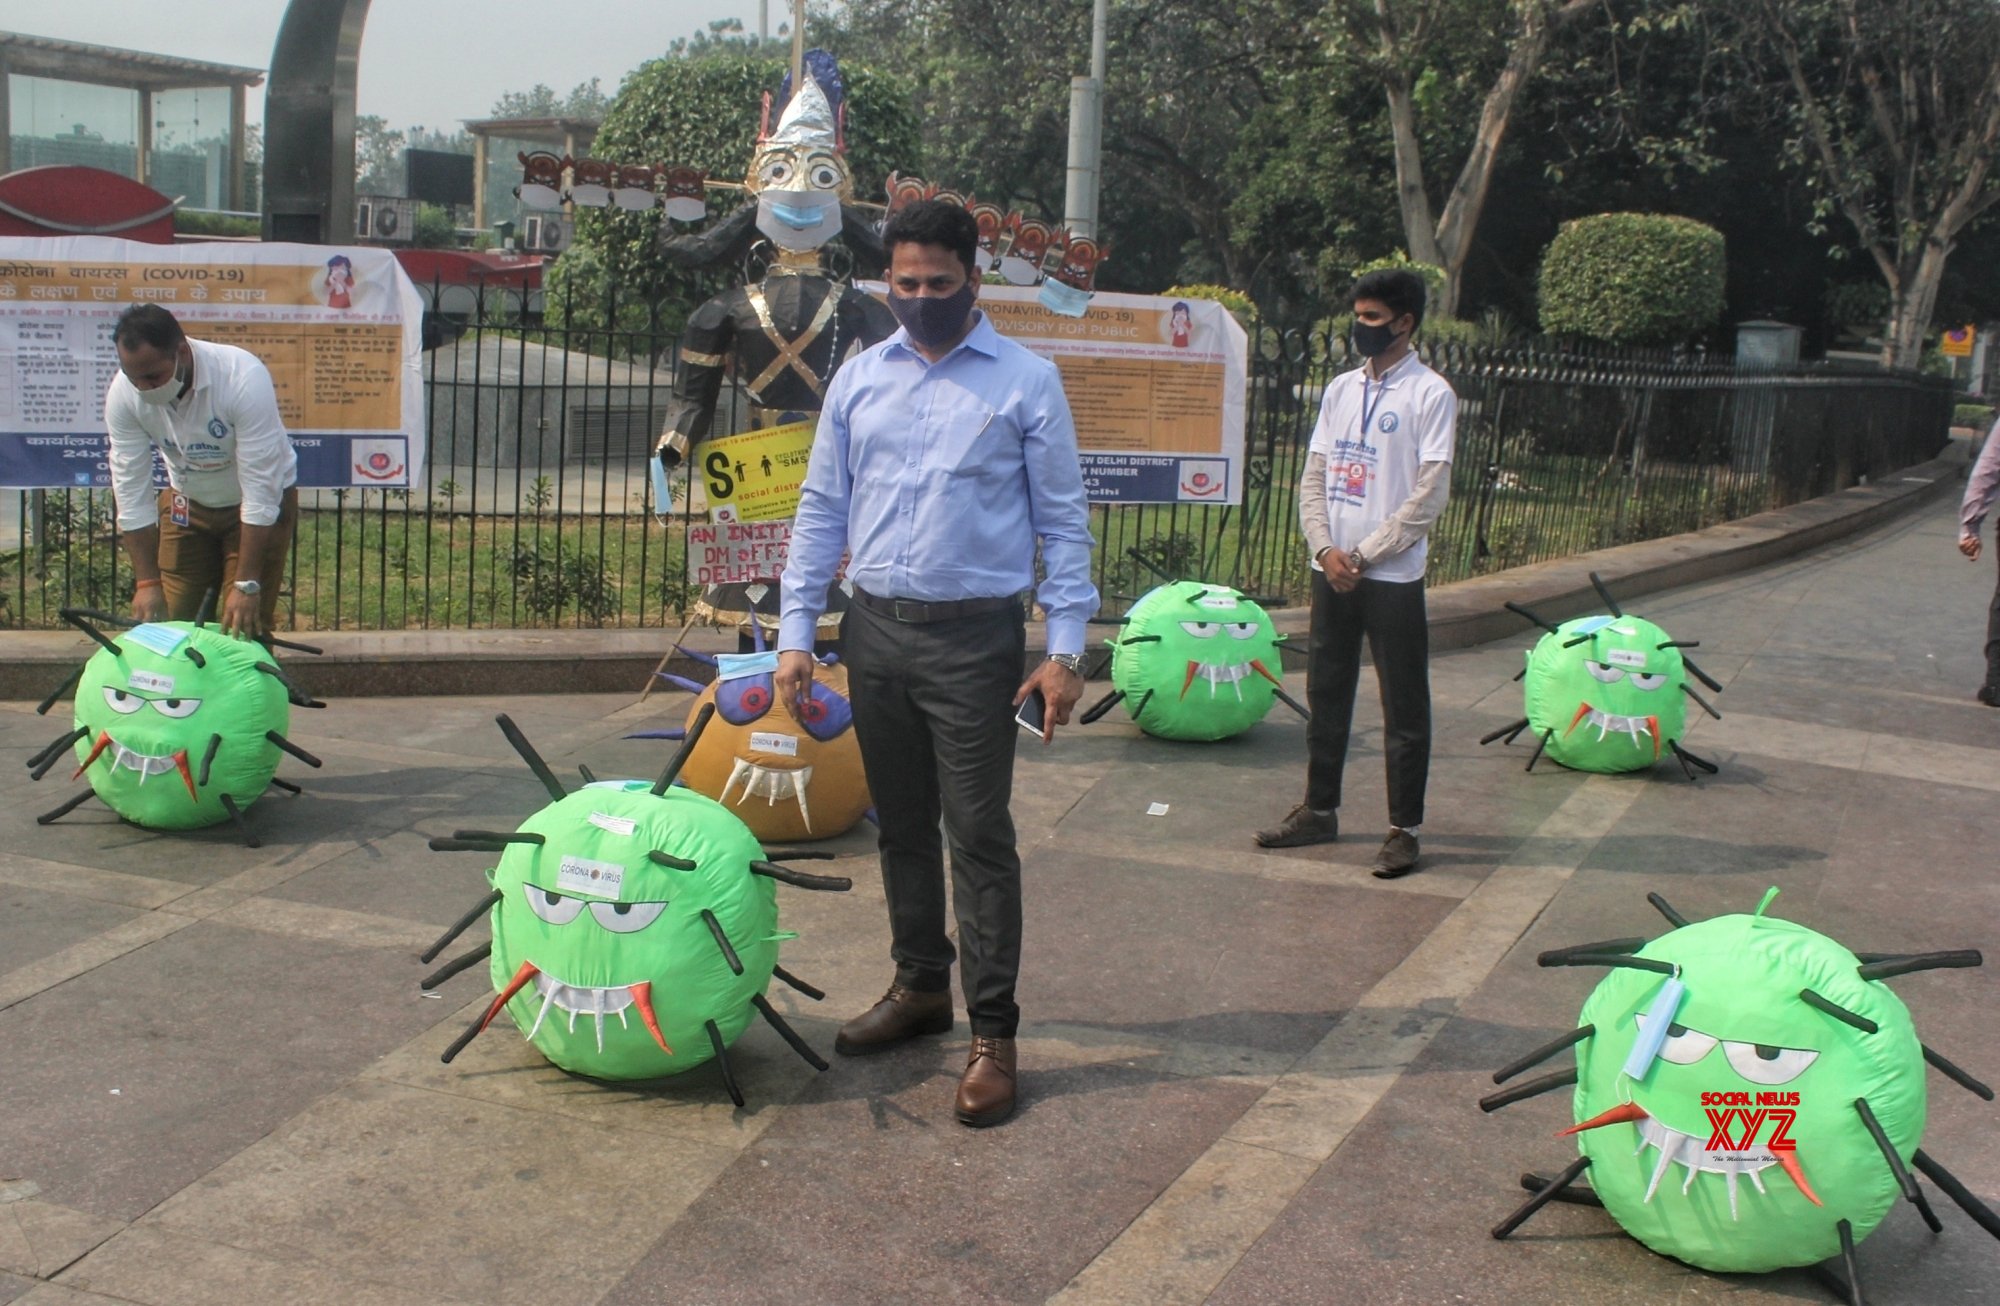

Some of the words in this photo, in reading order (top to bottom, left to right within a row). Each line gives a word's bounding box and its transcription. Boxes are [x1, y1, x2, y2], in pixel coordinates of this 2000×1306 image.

[0, 262, 55, 278] कोरोना
[69, 266, 129, 279] वायरस
[143, 267, 244, 283] (COVID-19)
[0, 281, 17, 298] के
[30, 284, 79, 299] लक्षण
[91, 281, 119, 301] एवं
[131, 287, 178, 300] बचाव
[189, 283, 208, 300] के
[221, 288, 268, 301] उपाय
[977, 302, 1061, 318] RONAVIRU
[1064, 305, 1136, 324] VID-19)
[993, 319, 1054, 333] DVISORY
[1058, 322, 1087, 335] FOR
[1090, 324, 1139, 338] PUBLIC
[26, 434, 98, 446] कार्यालय
[783, 456, 809, 467] SMS
[1079, 456, 1095, 465] EW
[1097, 456, 1127, 465] DELHI
[1130, 457, 1174, 467] DISTRICT
[1090, 467, 1138, 476] NUMBER
[705, 451, 734, 499] S
[738, 487, 770, 501] social
[774, 481, 802, 494] dista
[690, 526, 716, 545] AN
[727, 522, 792, 542] INITI
[704, 546, 729, 564] DM
[737, 541, 790, 561] OFFI
[698, 562, 761, 584] DELHI
[560, 863, 590, 877] CORONA
[601, 871, 622, 884] VIRUS
